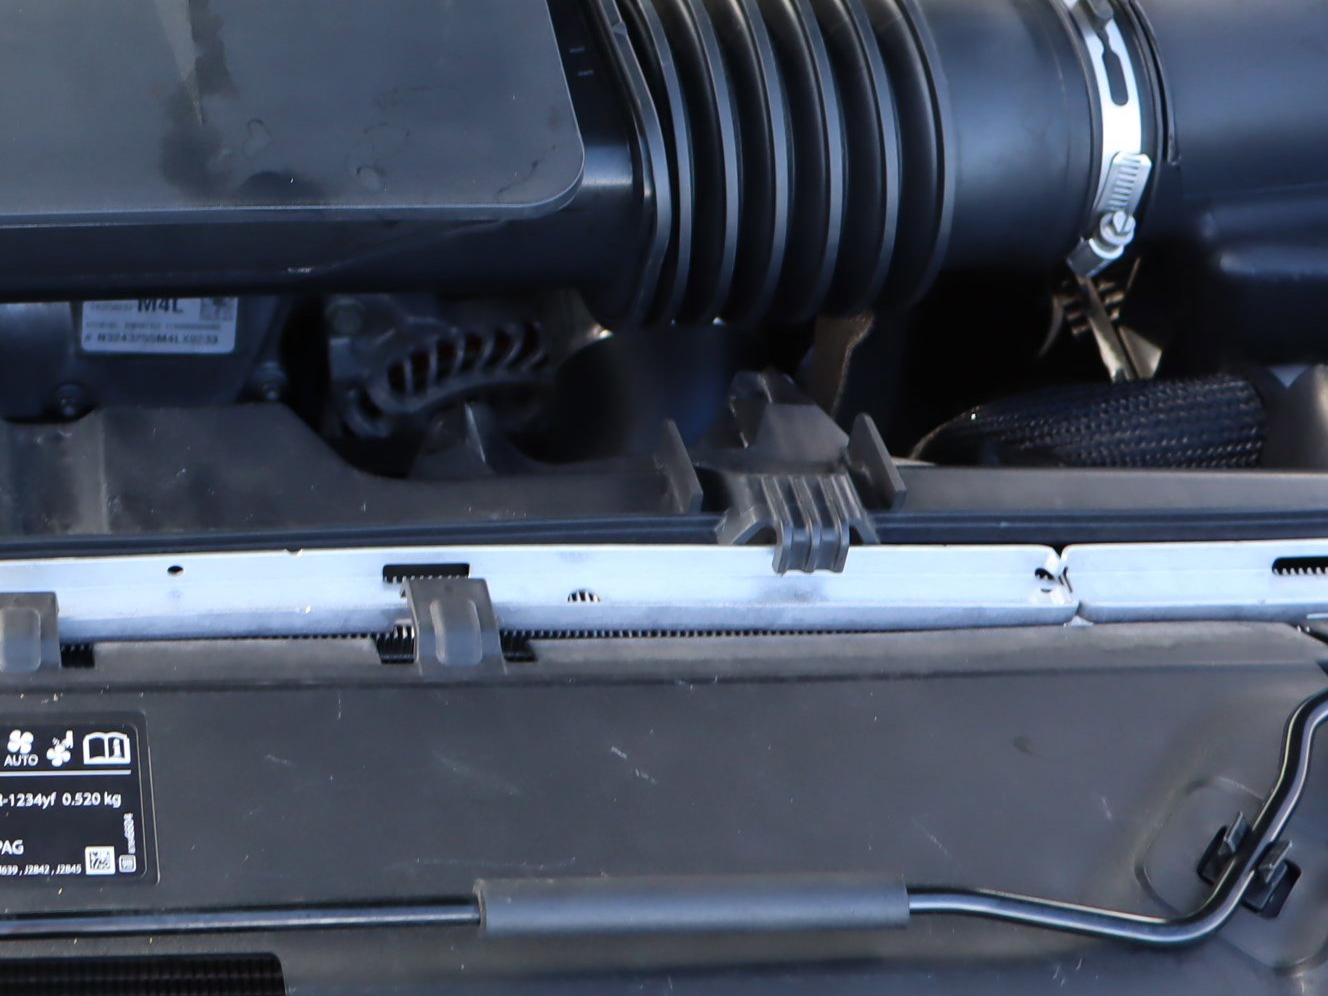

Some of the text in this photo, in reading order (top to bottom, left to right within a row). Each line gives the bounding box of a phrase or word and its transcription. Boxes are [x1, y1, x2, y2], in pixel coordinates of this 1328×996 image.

[136, 299, 183, 313] M4L
[3, 754, 39, 767] AUTO
[61, 791, 101, 807] 0.520
[103, 791, 122, 809] kg
